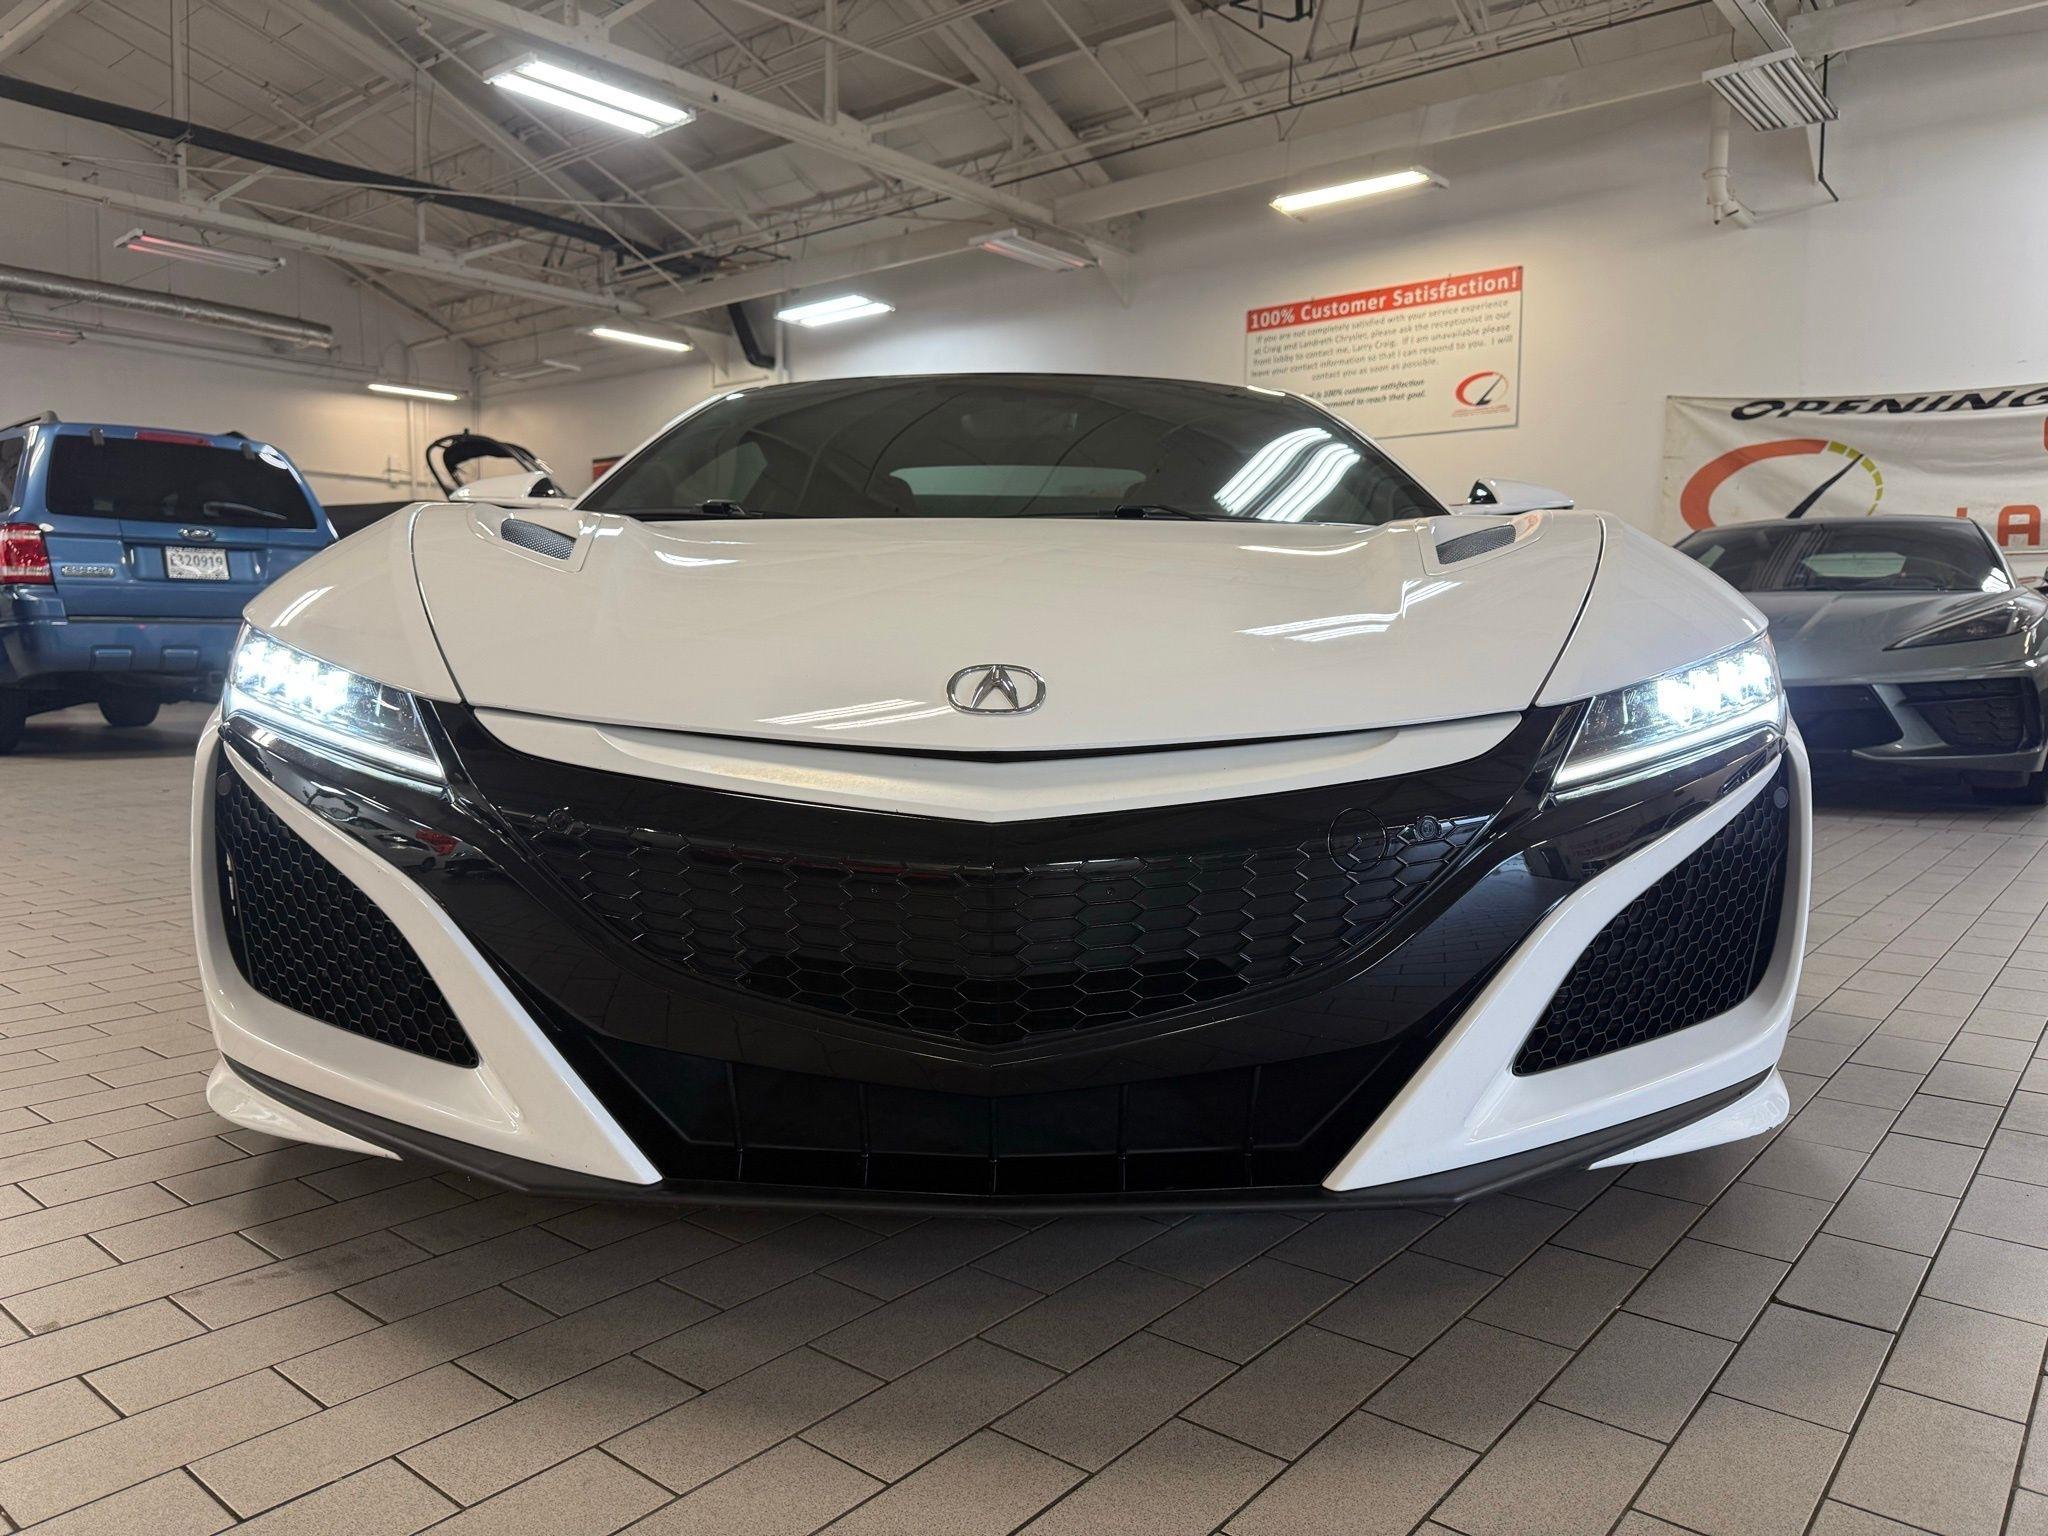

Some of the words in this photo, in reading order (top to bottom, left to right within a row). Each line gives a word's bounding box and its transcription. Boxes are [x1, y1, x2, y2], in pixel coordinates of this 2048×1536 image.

[1250, 307, 1295, 329] 100%
[1300, 295, 1386, 321] Customer
[1392, 270, 1517, 306] Satisfaction!
